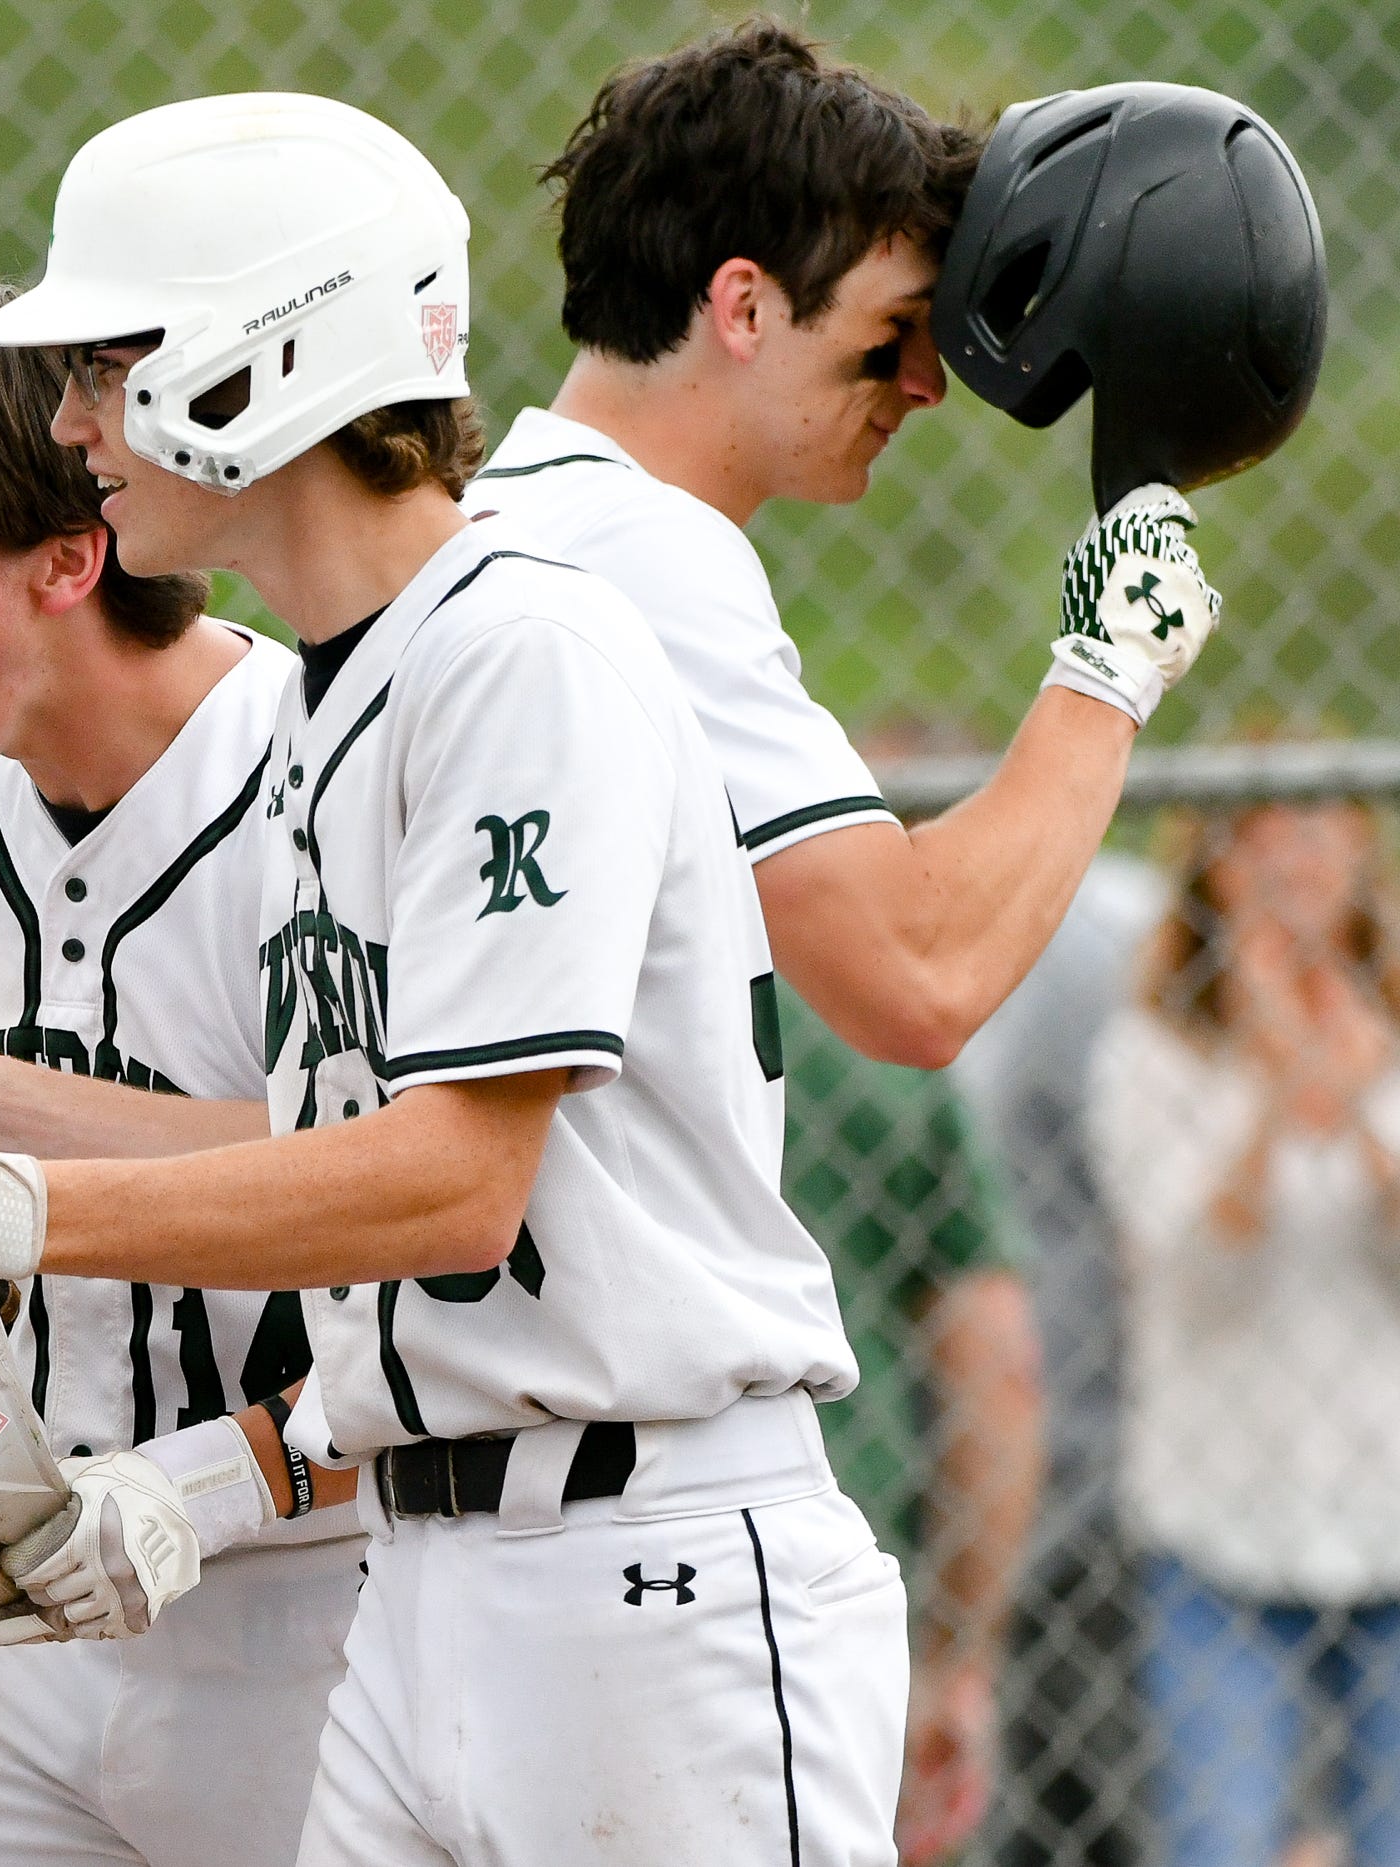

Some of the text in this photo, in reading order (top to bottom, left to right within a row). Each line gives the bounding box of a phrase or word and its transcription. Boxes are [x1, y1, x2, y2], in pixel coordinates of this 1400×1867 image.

[242, 270, 354, 335] RAWLINGS
[474, 809, 569, 922] R
[292, 1464, 306, 1477] IT
[296, 1479, 310, 1503] FOR
